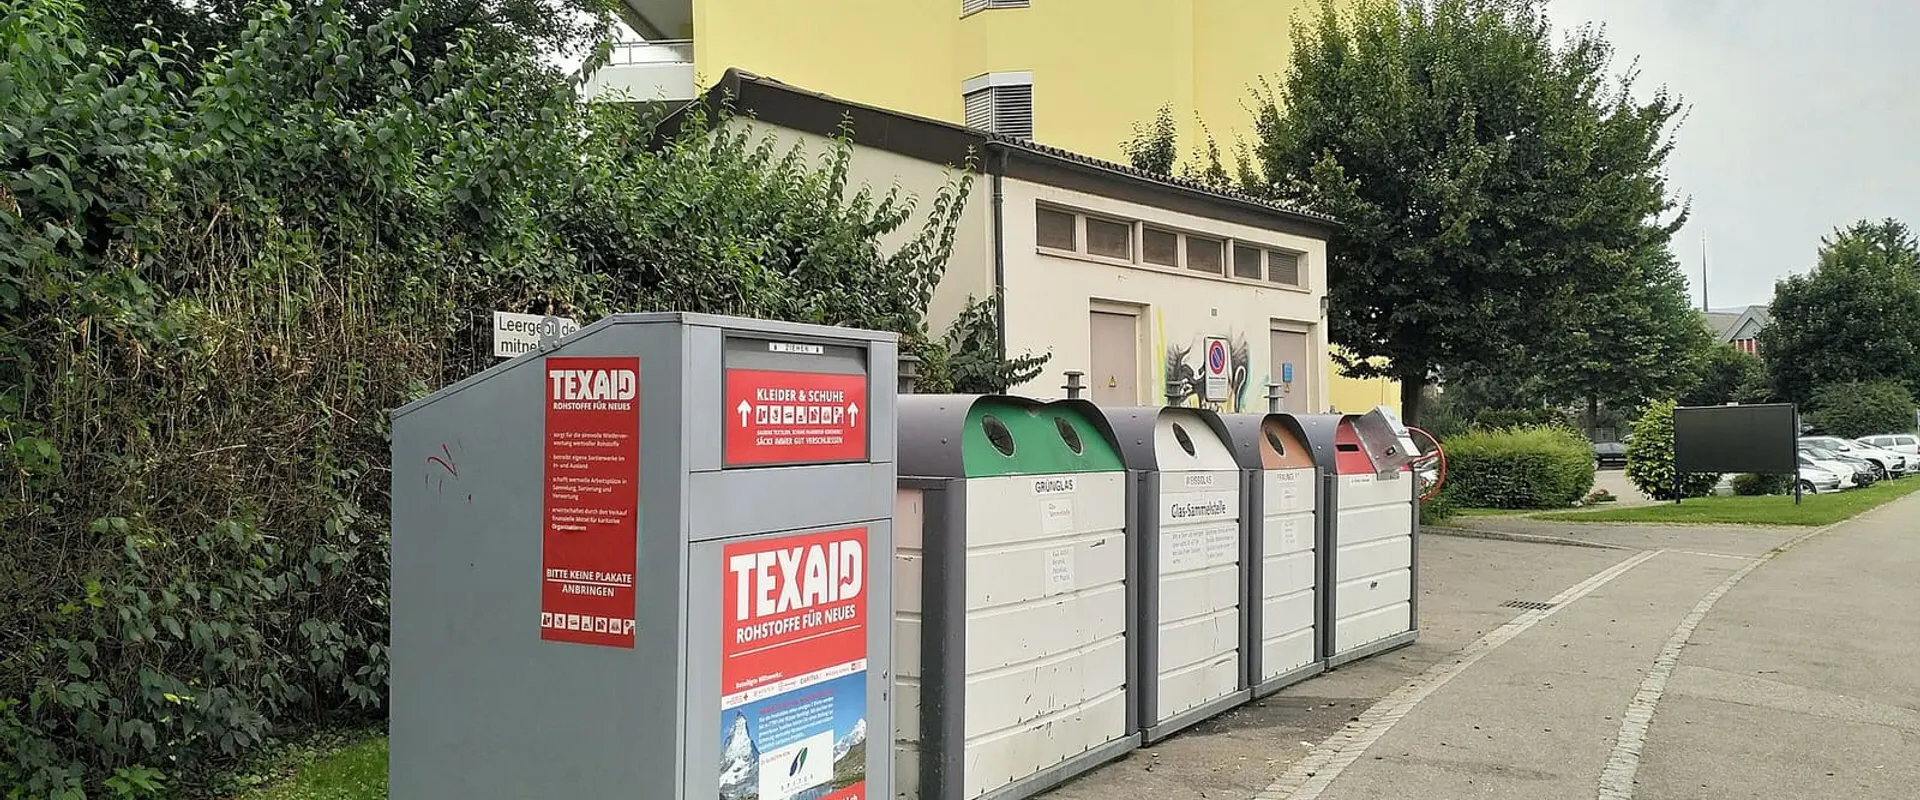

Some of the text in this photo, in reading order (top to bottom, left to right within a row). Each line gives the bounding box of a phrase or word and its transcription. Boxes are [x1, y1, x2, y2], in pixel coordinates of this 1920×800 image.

[549, 369, 636, 400] TEXAID
[757, 388, 844, 402] KLEIDER & SCHUHE
[553, 400, 632, 412] ROHSTOFFE FÜR NEUES
[1035, 479, 1073, 493] GRÜNGLAS
[546, 568, 632, 584] BITTE KEINE PLAKATE
[729, 539, 863, 622] TEXAID
[562, 584, 615, 597] ANBRINGEN
[736, 604, 856, 644] ROHSTOFFE FÜR NEUES
